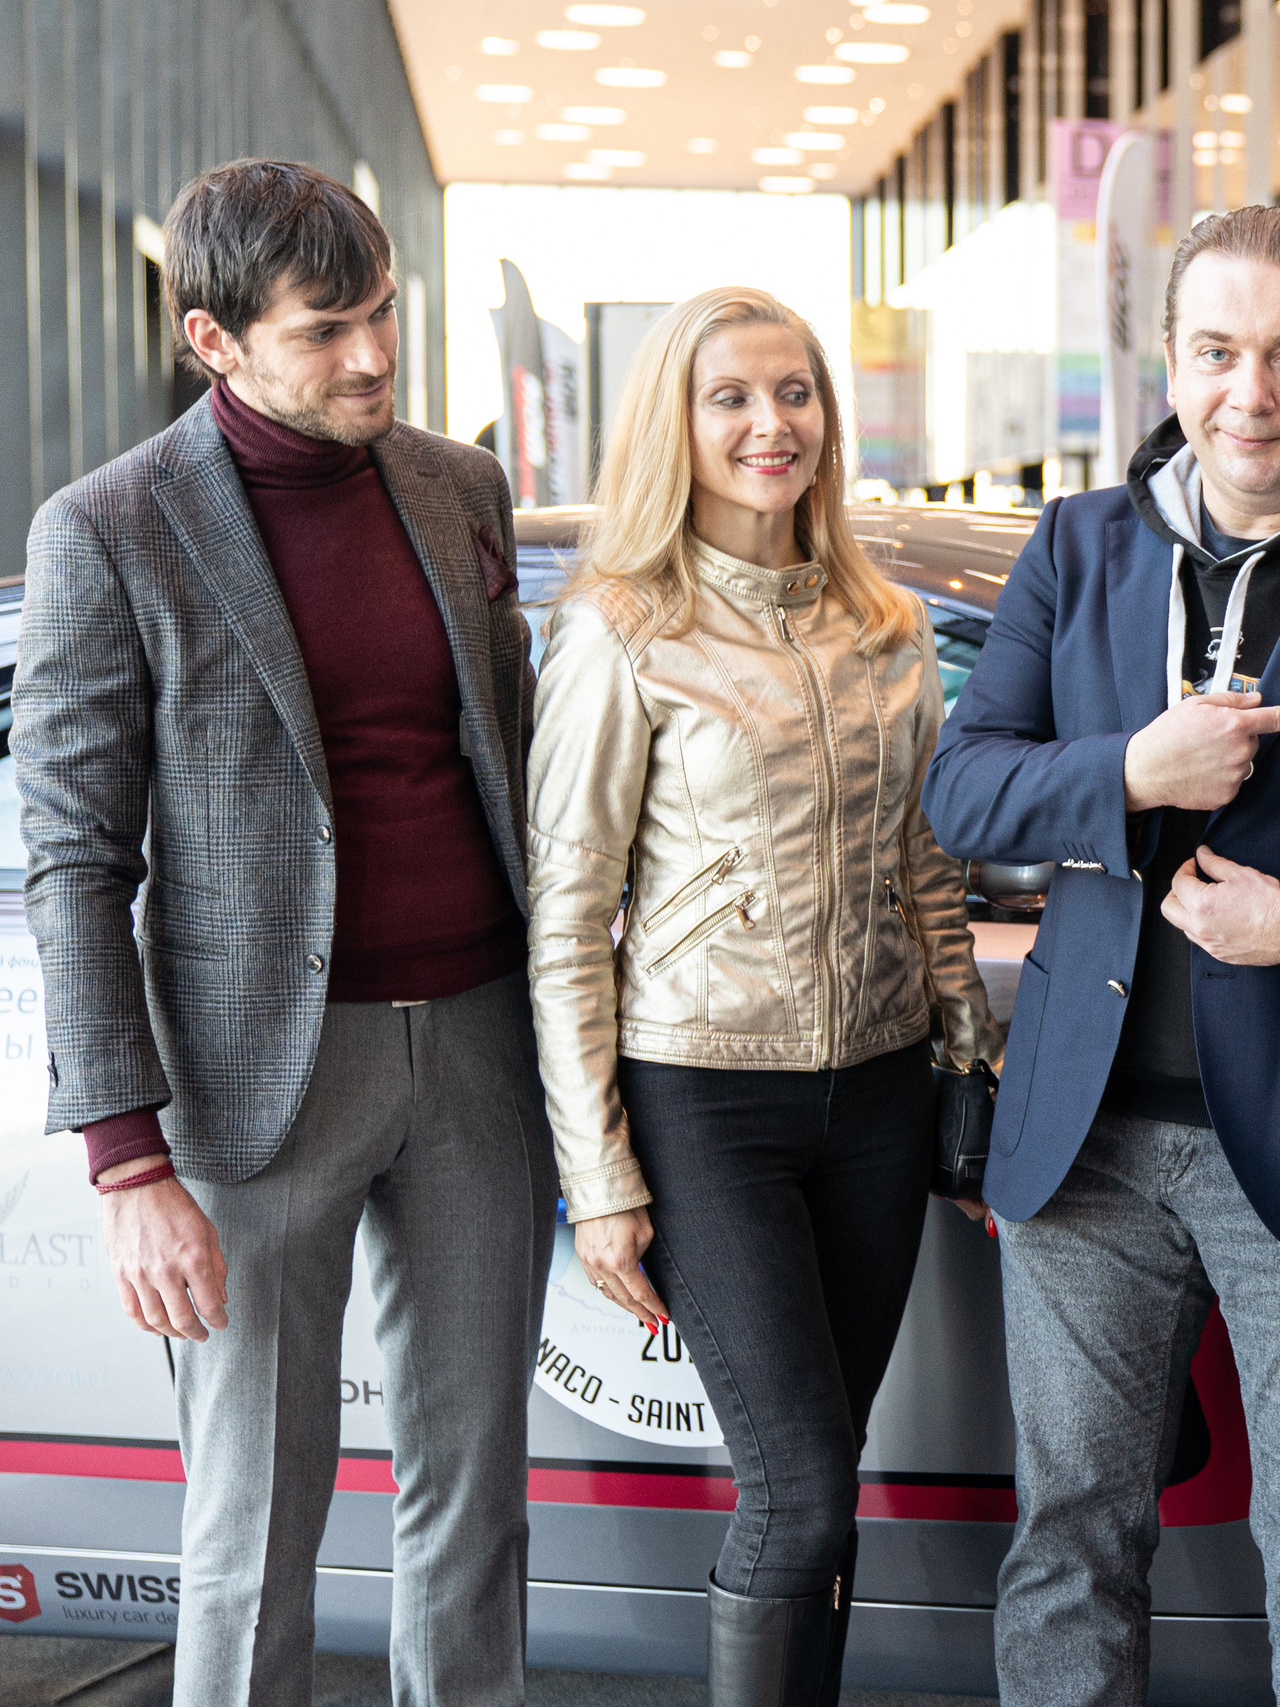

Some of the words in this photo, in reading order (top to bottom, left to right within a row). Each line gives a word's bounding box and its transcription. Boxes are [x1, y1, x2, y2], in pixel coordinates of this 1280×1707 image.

[0, 1232, 94, 1267] LAST
[536, 1337, 603, 1405] NACO
[627, 1394, 706, 1432] SAINT
[62, 1605, 118, 1624] luxury
[122, 1610, 150, 1624] car
[155, 1611, 179, 1626] de
